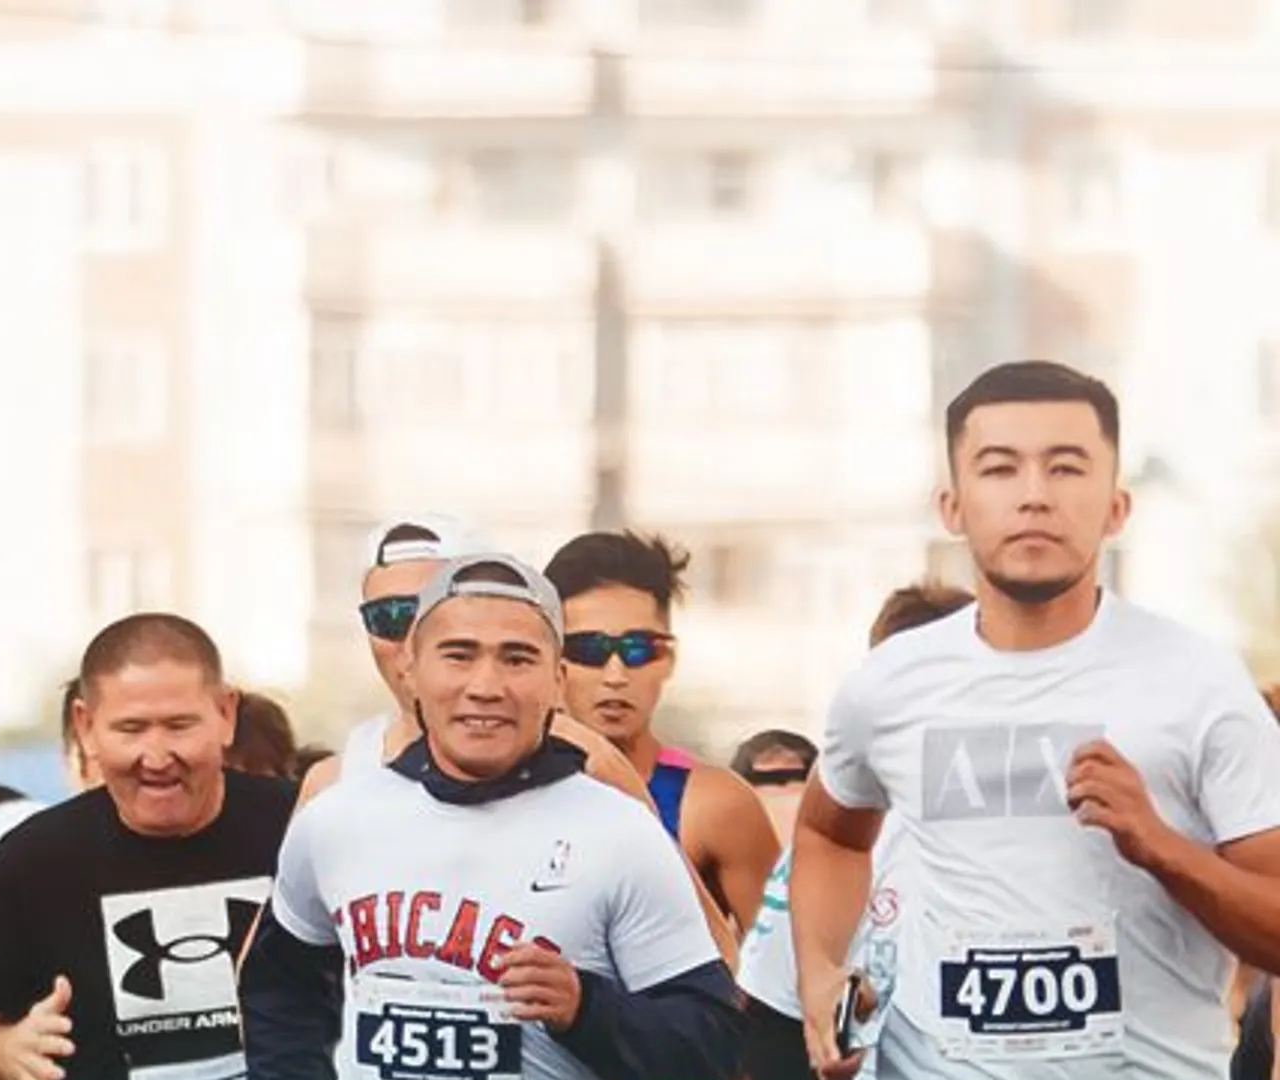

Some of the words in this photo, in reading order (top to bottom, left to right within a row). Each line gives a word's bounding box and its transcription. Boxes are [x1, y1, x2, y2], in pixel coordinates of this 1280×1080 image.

[956, 963, 1098, 1016] 4700
[116, 1017, 191, 1037] UNDER
[195, 1010, 242, 1029] ARM
[370, 1019, 499, 1070] 4513
